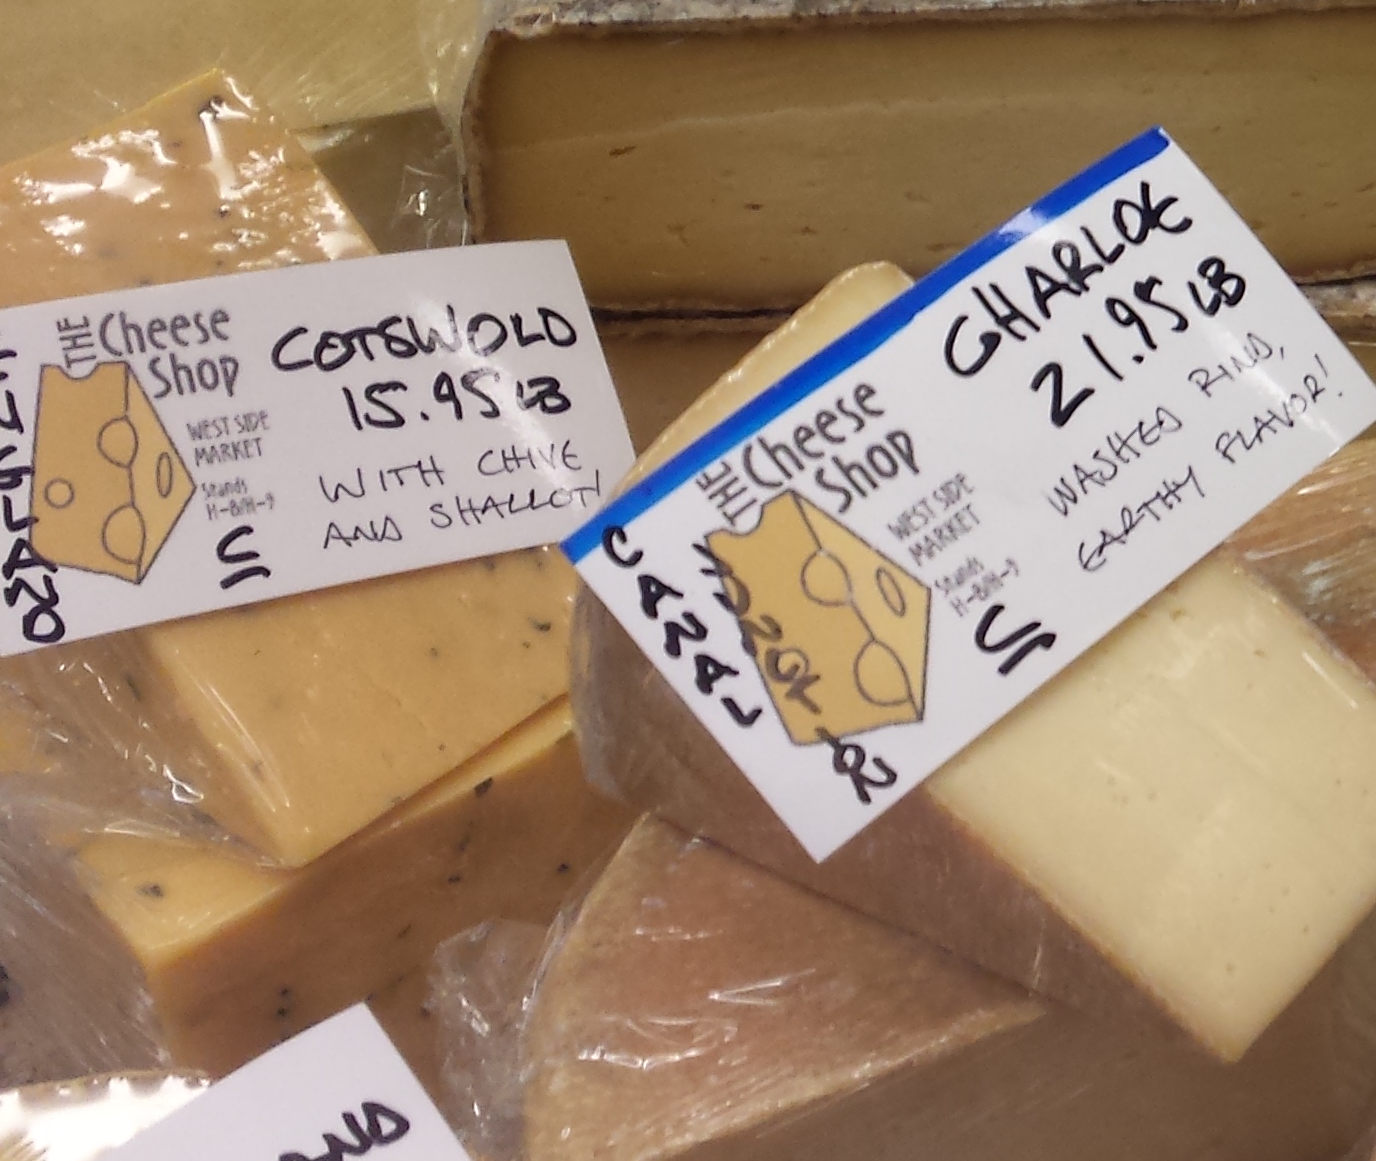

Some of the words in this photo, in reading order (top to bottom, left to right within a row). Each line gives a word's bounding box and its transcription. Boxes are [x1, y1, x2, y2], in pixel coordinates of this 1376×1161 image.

[56, 315, 99, 369] THE
[98, 305, 232, 360] Cheese
[270, 304, 579, 374] COTSWOLD
[149, 352, 242, 401] Shop
[186, 415, 230, 441] WEST
[233, 410, 270, 434] SIDE
[194, 437, 263, 467] MARKET
[697, 459, 758, 527] THE
[758, 378, 887, 494] Cheese
[318, 462, 446, 503] WITH
[478, 438, 584, 477] CHIVE
[815, 427, 923, 518] Shop
[1046, 405, 1186, 518] WASHED
[321, 516, 404, 551] AND
[887, 497, 936, 540] WEST
[908, 502, 980, 567] MARKET
[1076, 474, 1207, 574] EARTHY
[601, 524, 763, 728] CANAL
